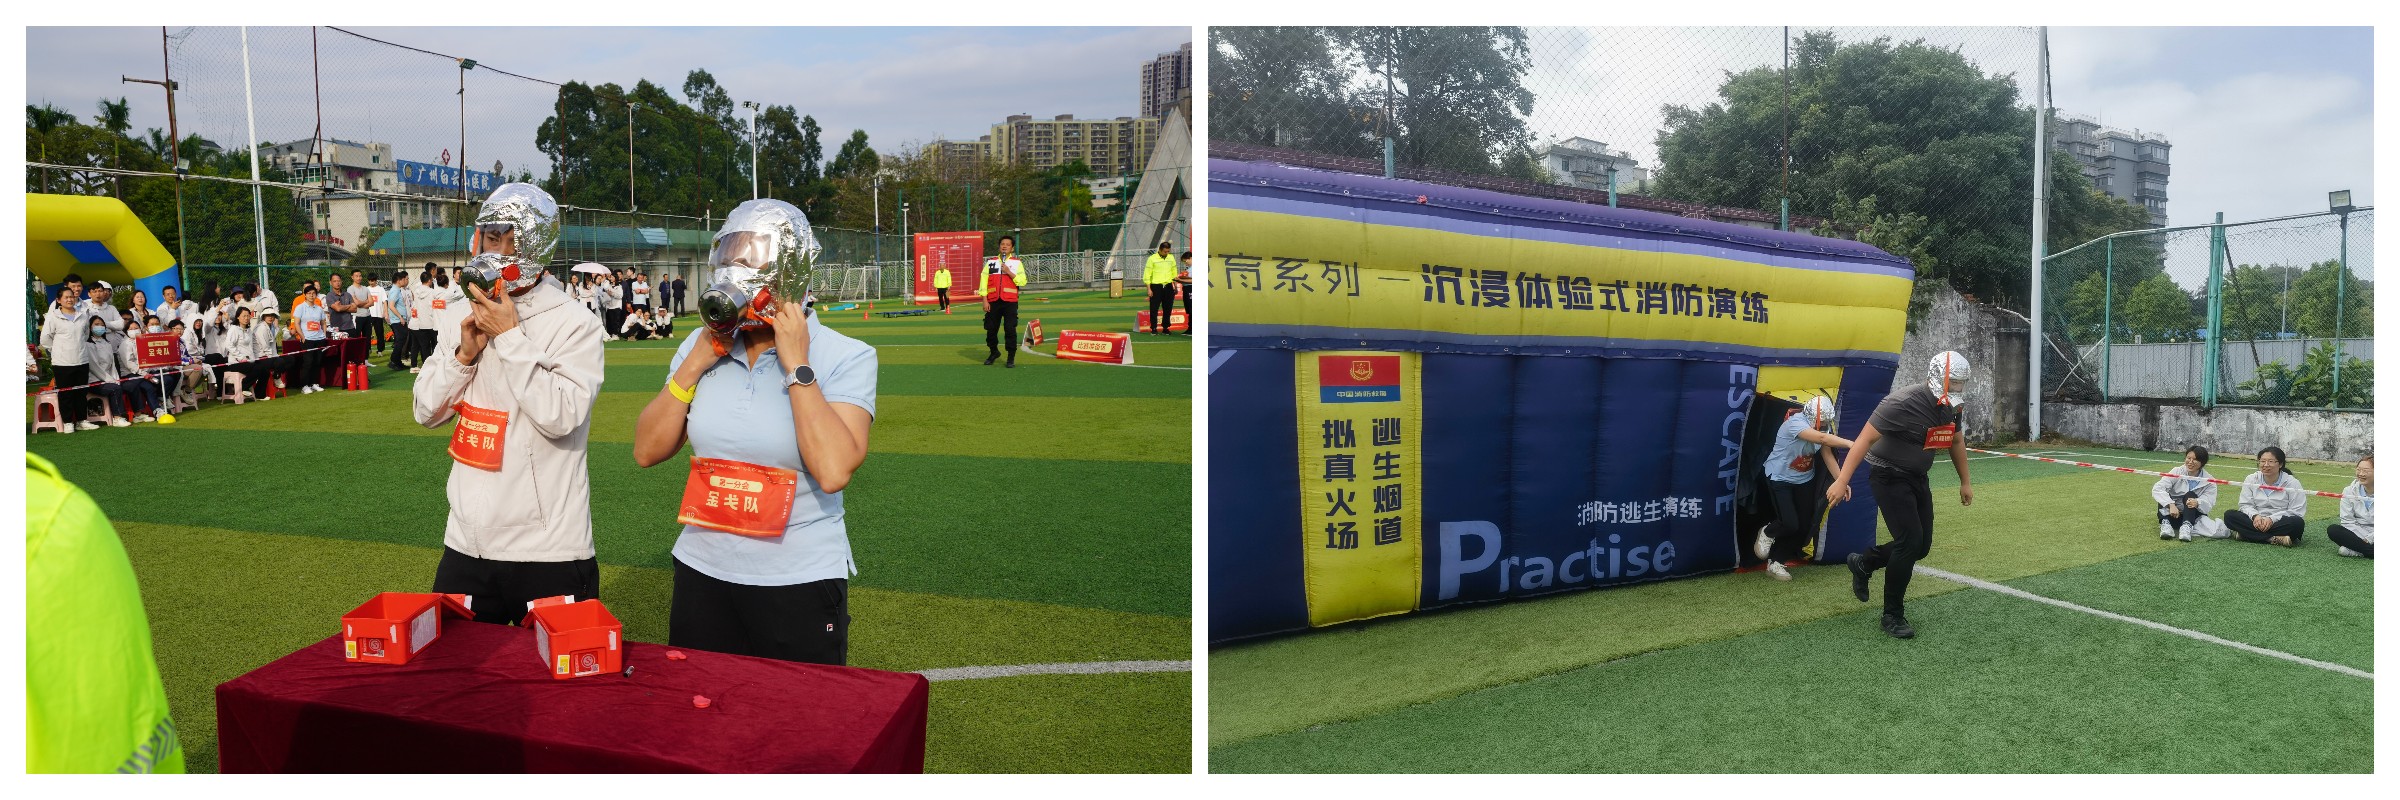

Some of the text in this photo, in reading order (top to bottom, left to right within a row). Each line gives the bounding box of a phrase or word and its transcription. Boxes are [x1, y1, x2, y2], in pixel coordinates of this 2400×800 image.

[1321, 418, 1359, 550] 拟真火场
[1372, 417, 1402, 546] 逃生烟道
[1715, 364, 1758, 515] ESCAPE
[1438, 520, 1676, 600] Practise
[1577, 496, 1702, 526] 消防逃生演练
